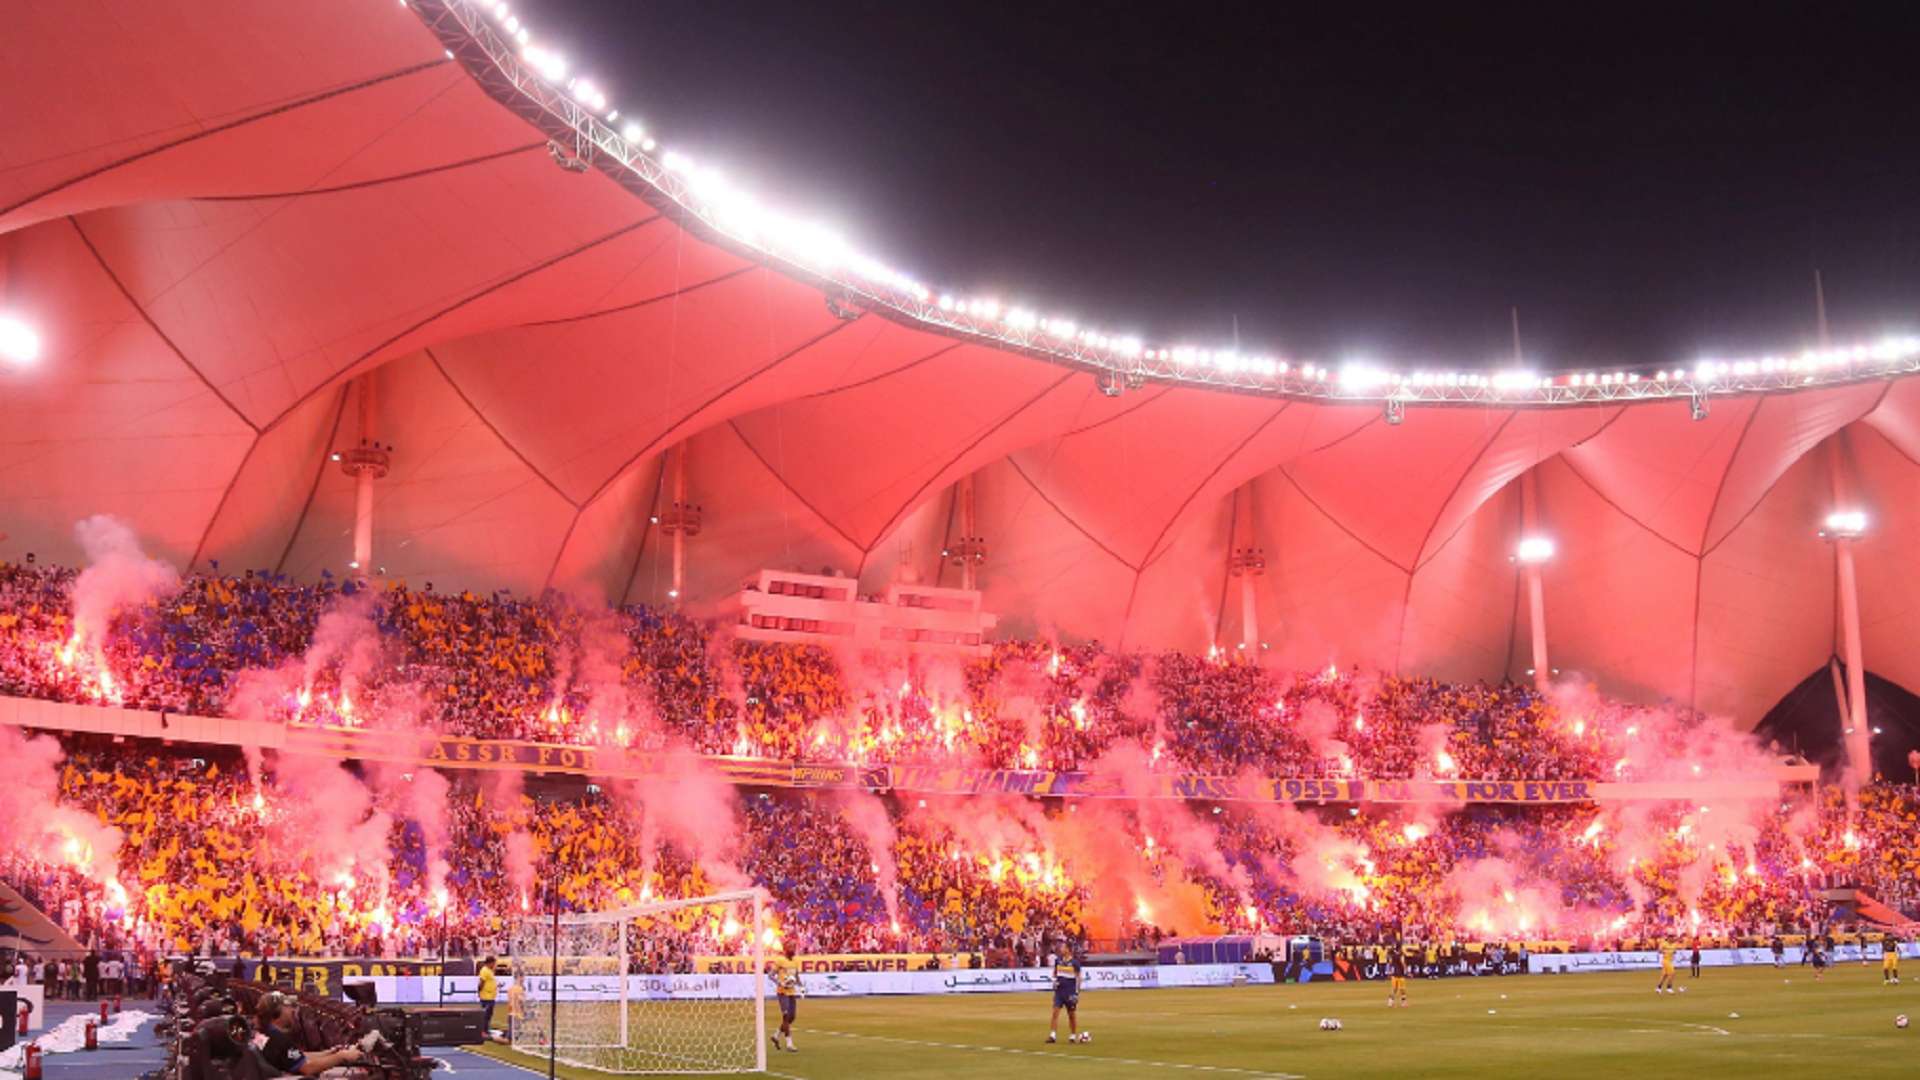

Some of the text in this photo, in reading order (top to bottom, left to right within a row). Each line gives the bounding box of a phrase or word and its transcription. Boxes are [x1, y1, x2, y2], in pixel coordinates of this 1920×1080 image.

[1171, 777, 1339, 800] NASS 1955
[1466, 782, 1517, 800] FOR
[1525, 782, 1591, 800] EVER
